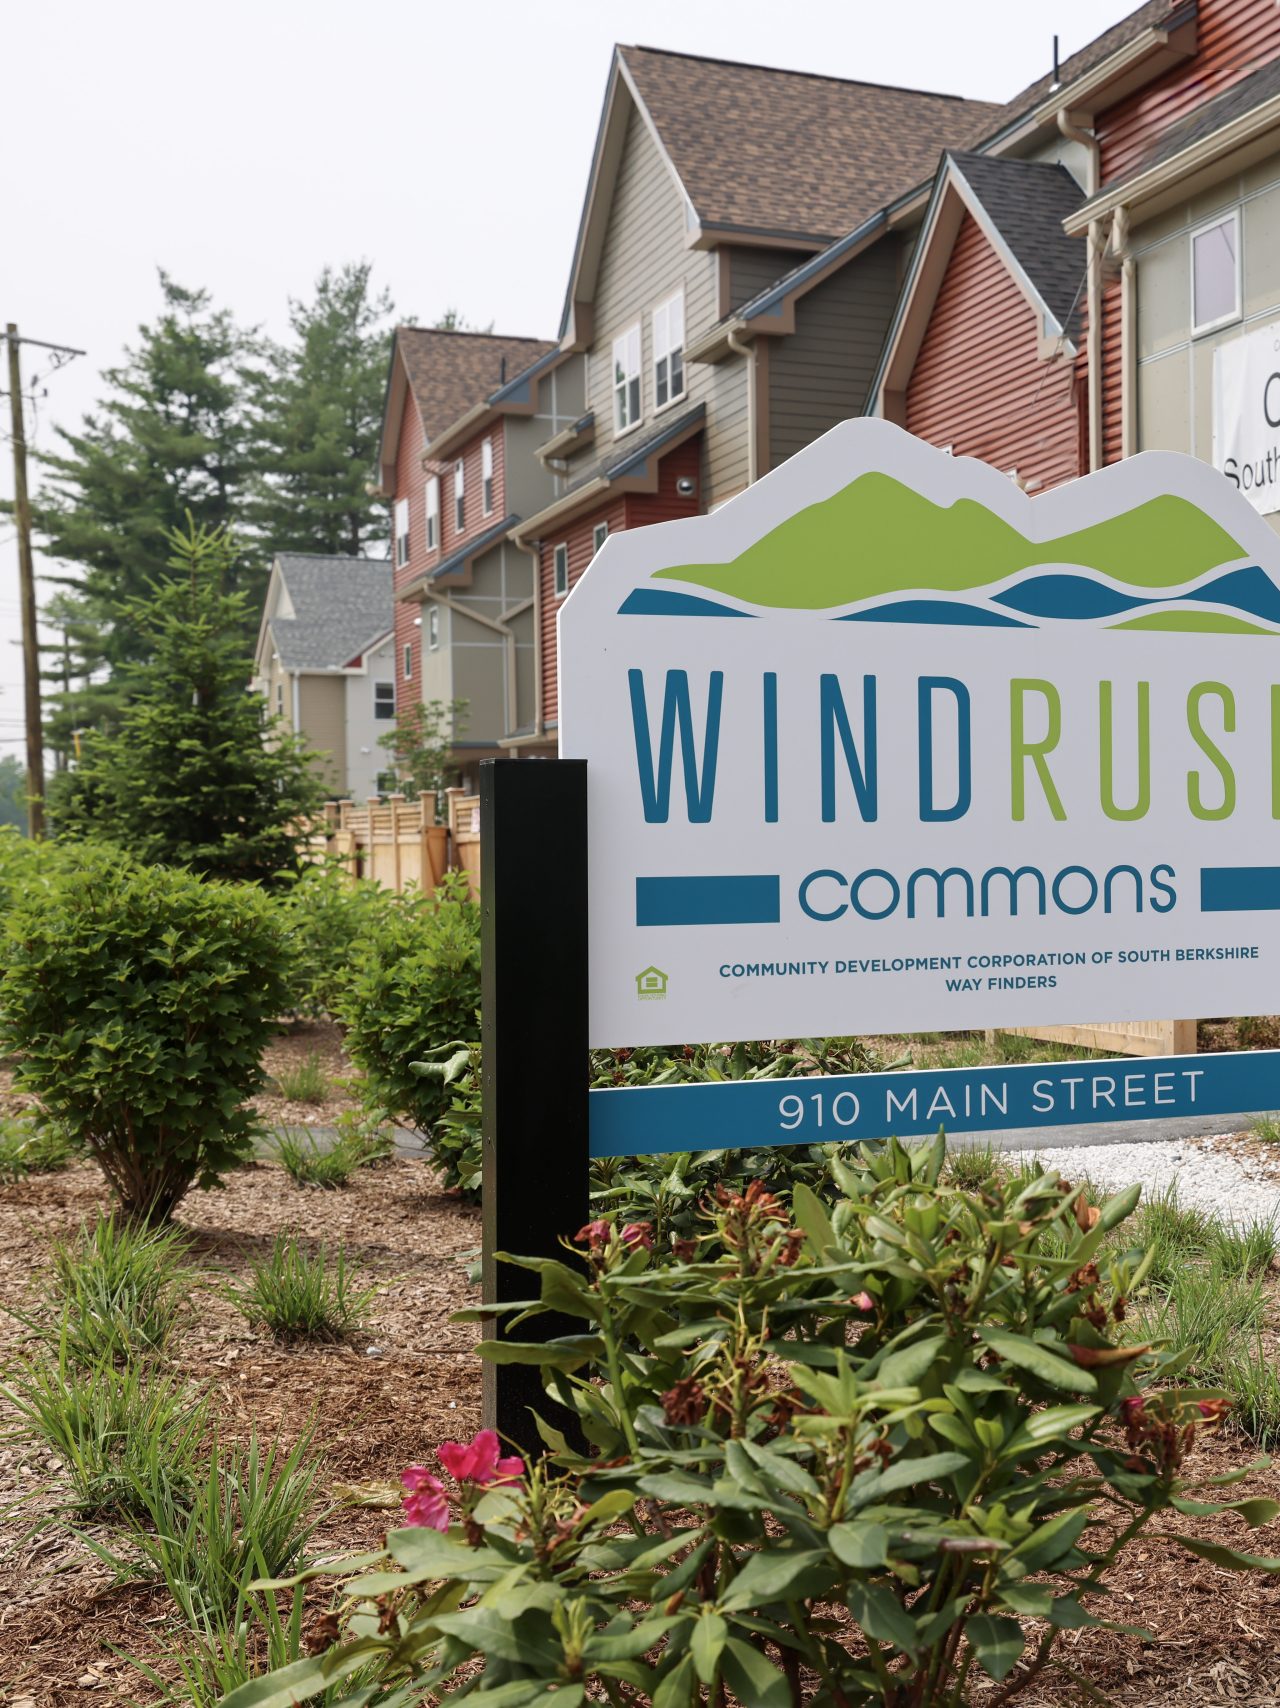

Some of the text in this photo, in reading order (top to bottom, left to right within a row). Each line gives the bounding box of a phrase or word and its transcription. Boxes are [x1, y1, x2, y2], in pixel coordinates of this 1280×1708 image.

[797, 864, 1177, 922] commons
[719, 946, 1259, 978] COMMUNITY DEVELOPMENT CORPORATION OF SOUTH BERKSHIRE
[945, 975, 1057, 993] WAY FINDERS
[778, 1070, 1205, 1130] 910 MAIN STREET
